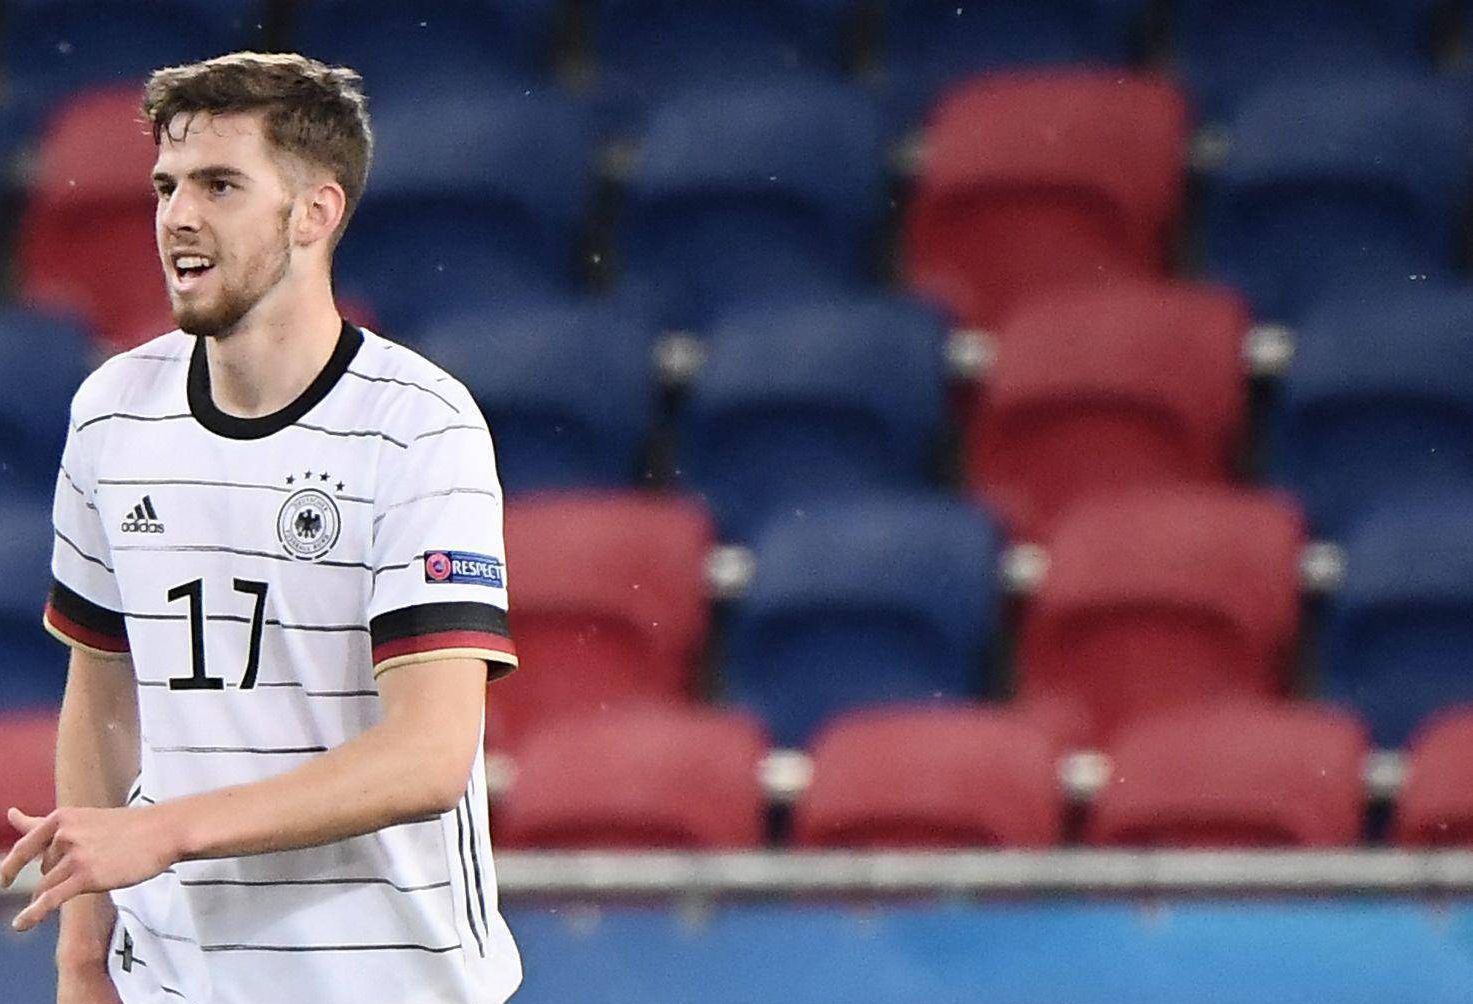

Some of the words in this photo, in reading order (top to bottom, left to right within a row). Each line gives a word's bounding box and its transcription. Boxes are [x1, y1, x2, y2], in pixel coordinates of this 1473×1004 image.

[121, 519, 165, 534] adidas
[452, 560, 502, 580] RESPECT
[168, 577, 268, 690] 17
